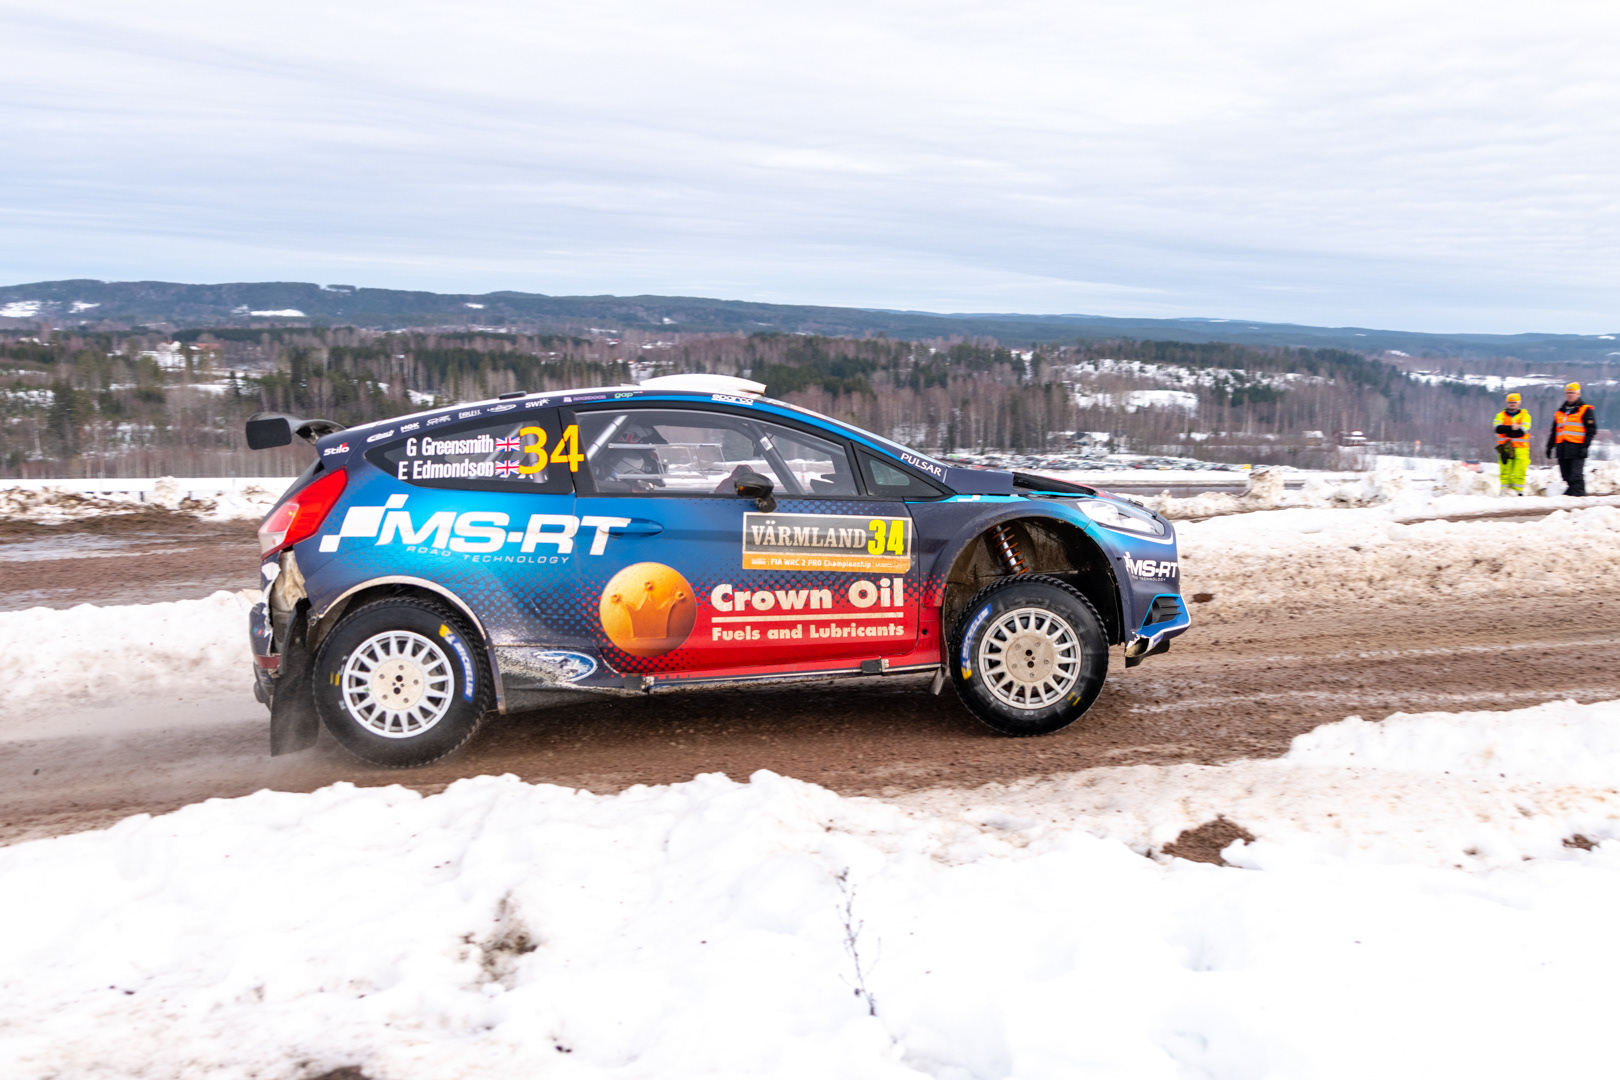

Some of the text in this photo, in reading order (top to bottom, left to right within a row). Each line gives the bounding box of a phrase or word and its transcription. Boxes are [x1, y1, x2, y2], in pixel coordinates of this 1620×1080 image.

[711, 394, 753, 405] sparco
[400, 422, 420, 433] NGK
[323, 443, 350, 456] Stilo
[406, 434, 494, 457] G Greensmith
[519, 424, 585, 475] 34
[398, 458, 495, 480] E Edmondson
[900, 452, 942, 476] PULSAR
[750, 519, 905, 556] VÄRMLAND 34
[406, 545, 570, 564] ROAD TECHNOLOGY
[783, 558, 800, 566] WRC
[807, 559, 822, 567] PRO
[823, 559, 872, 568] Championship
[710, 577, 904, 612] Crown Oil
[712, 622, 904, 641] Fuels and Lubricants
[454, 641, 475, 698] MICHELIN
